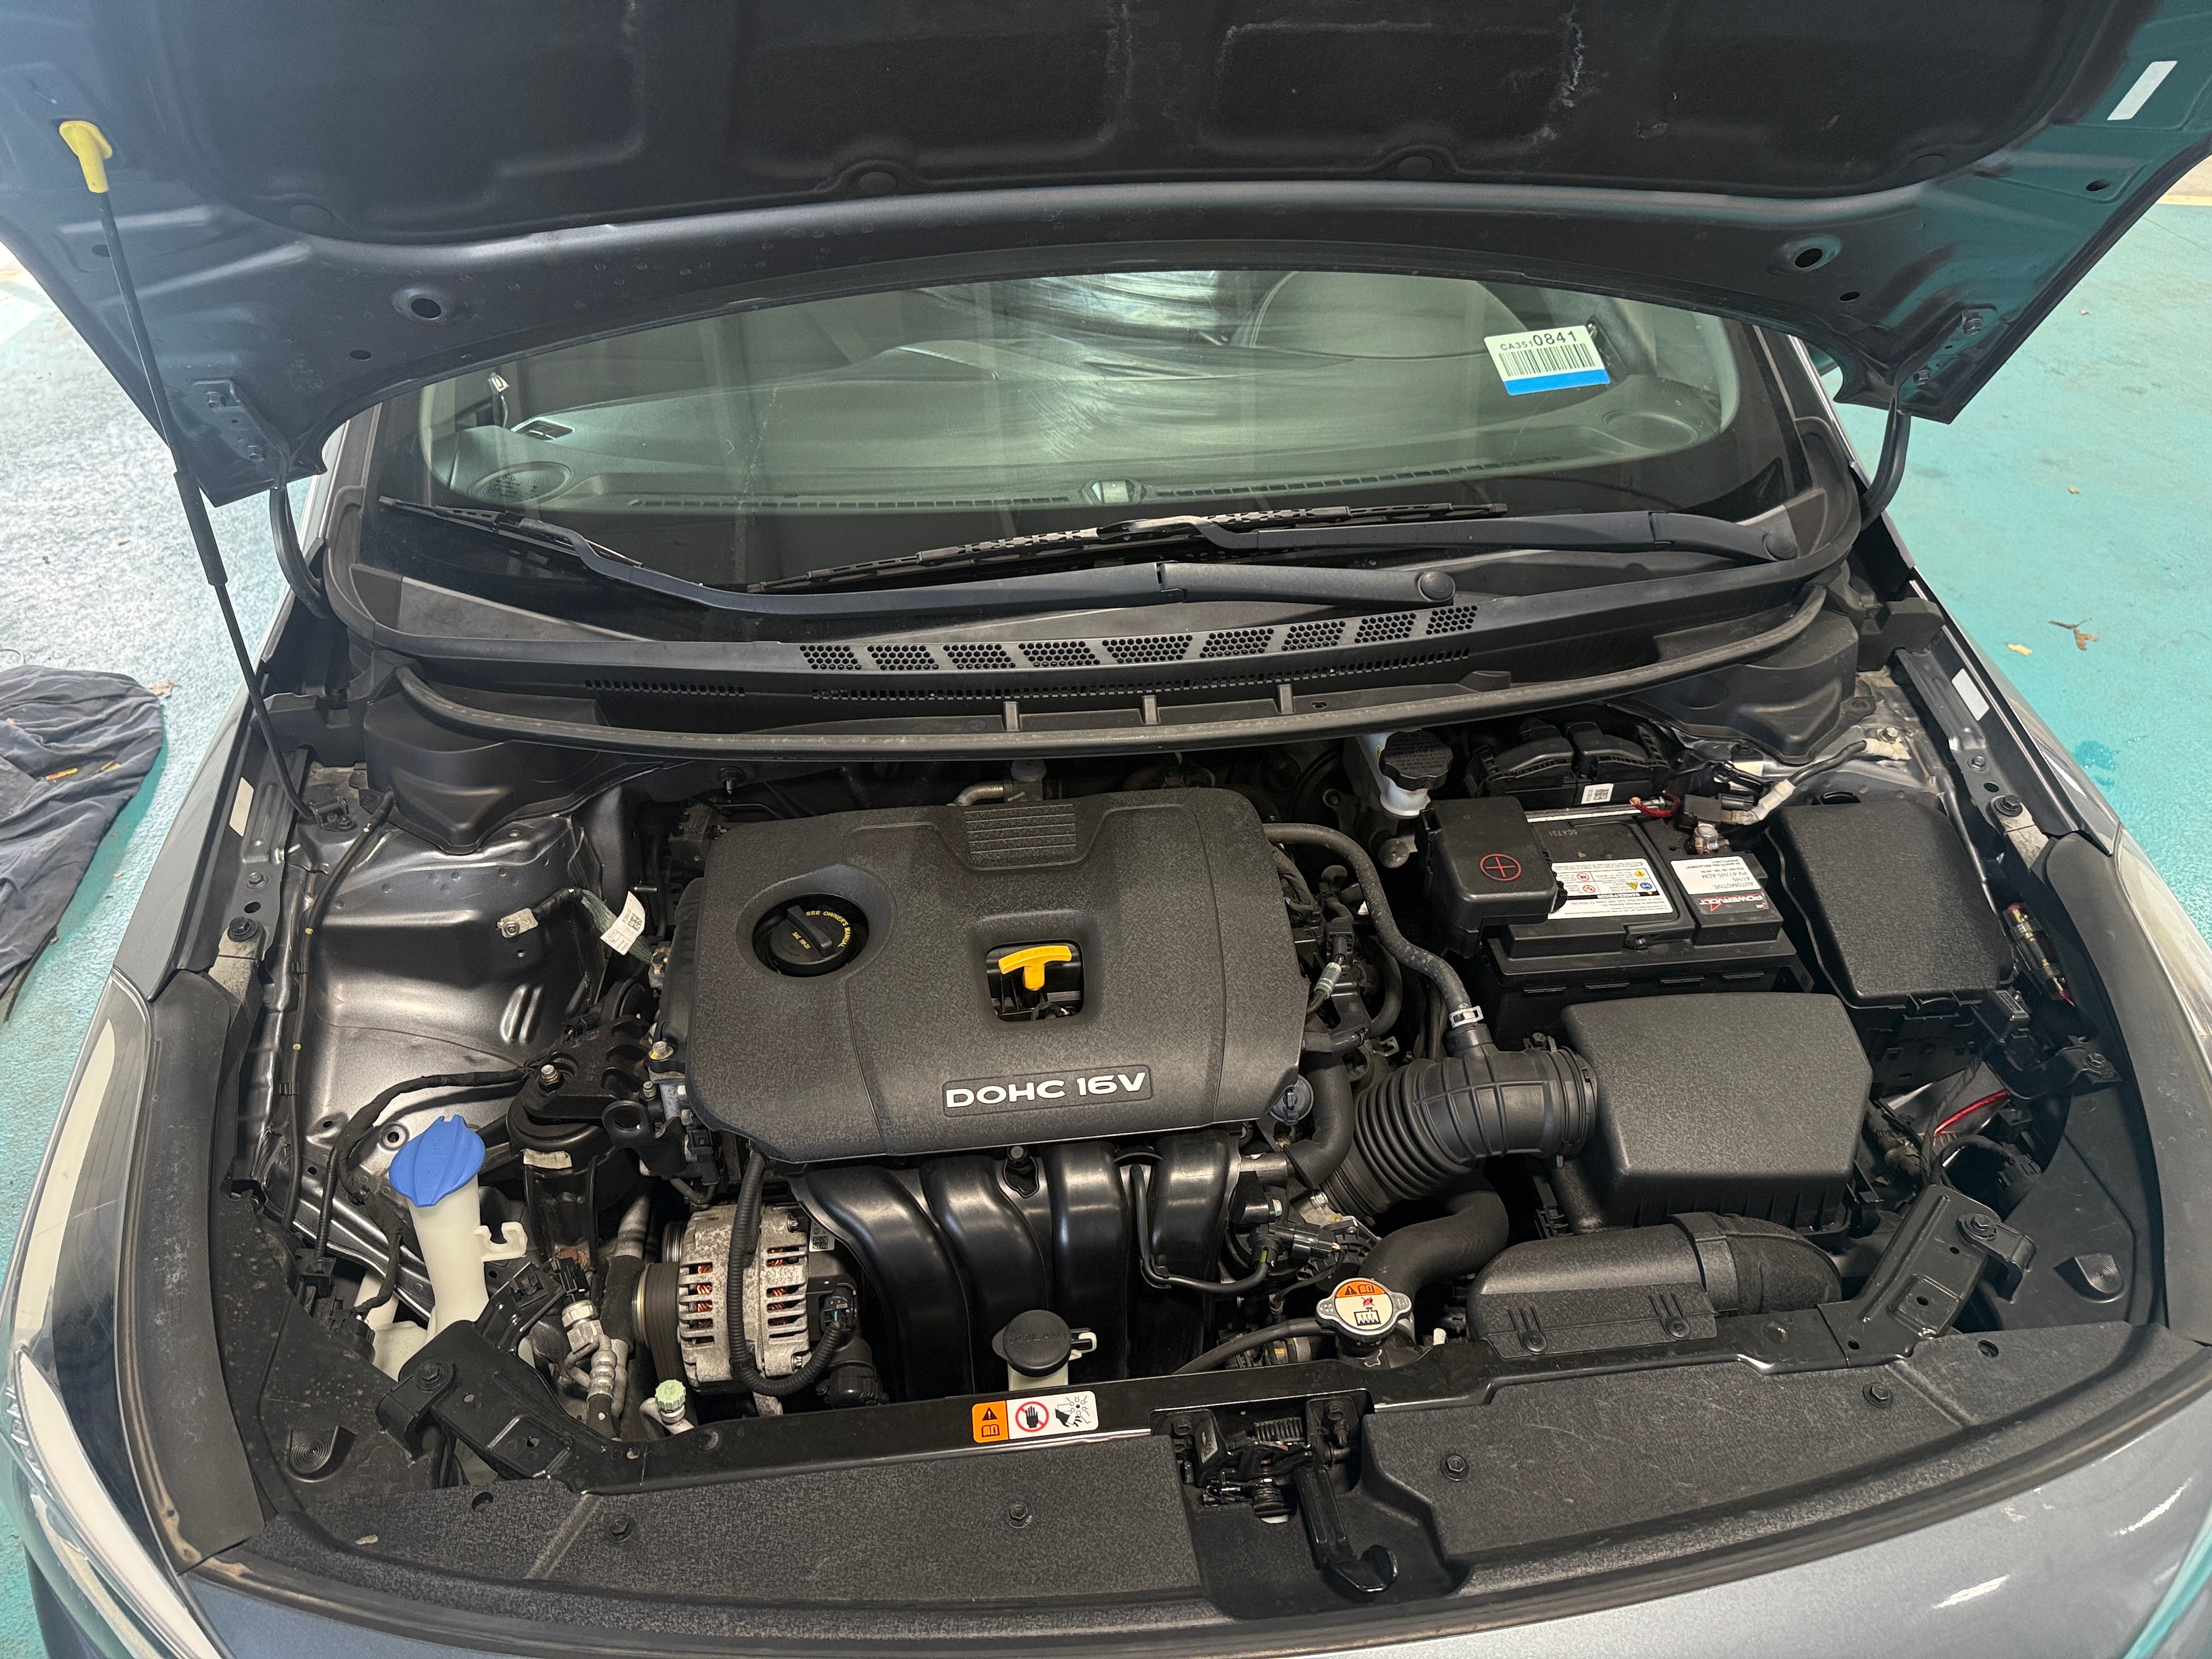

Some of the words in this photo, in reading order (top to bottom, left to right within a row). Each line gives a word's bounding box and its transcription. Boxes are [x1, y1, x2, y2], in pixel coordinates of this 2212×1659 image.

[1500, 330, 1578, 351] CA3510841
[1712, 881, 1754, 889] AUTOMOTIVE
[1699, 895, 1763, 905] POWERVOLT
[792, 932, 802, 941] SAE
[822, 911, 849, 927] OWNER'S
[837, 927, 851, 947] MANUAL
[946, 1080, 1066, 1109] DOHC
[1076, 1072, 1147, 1097] 16V
